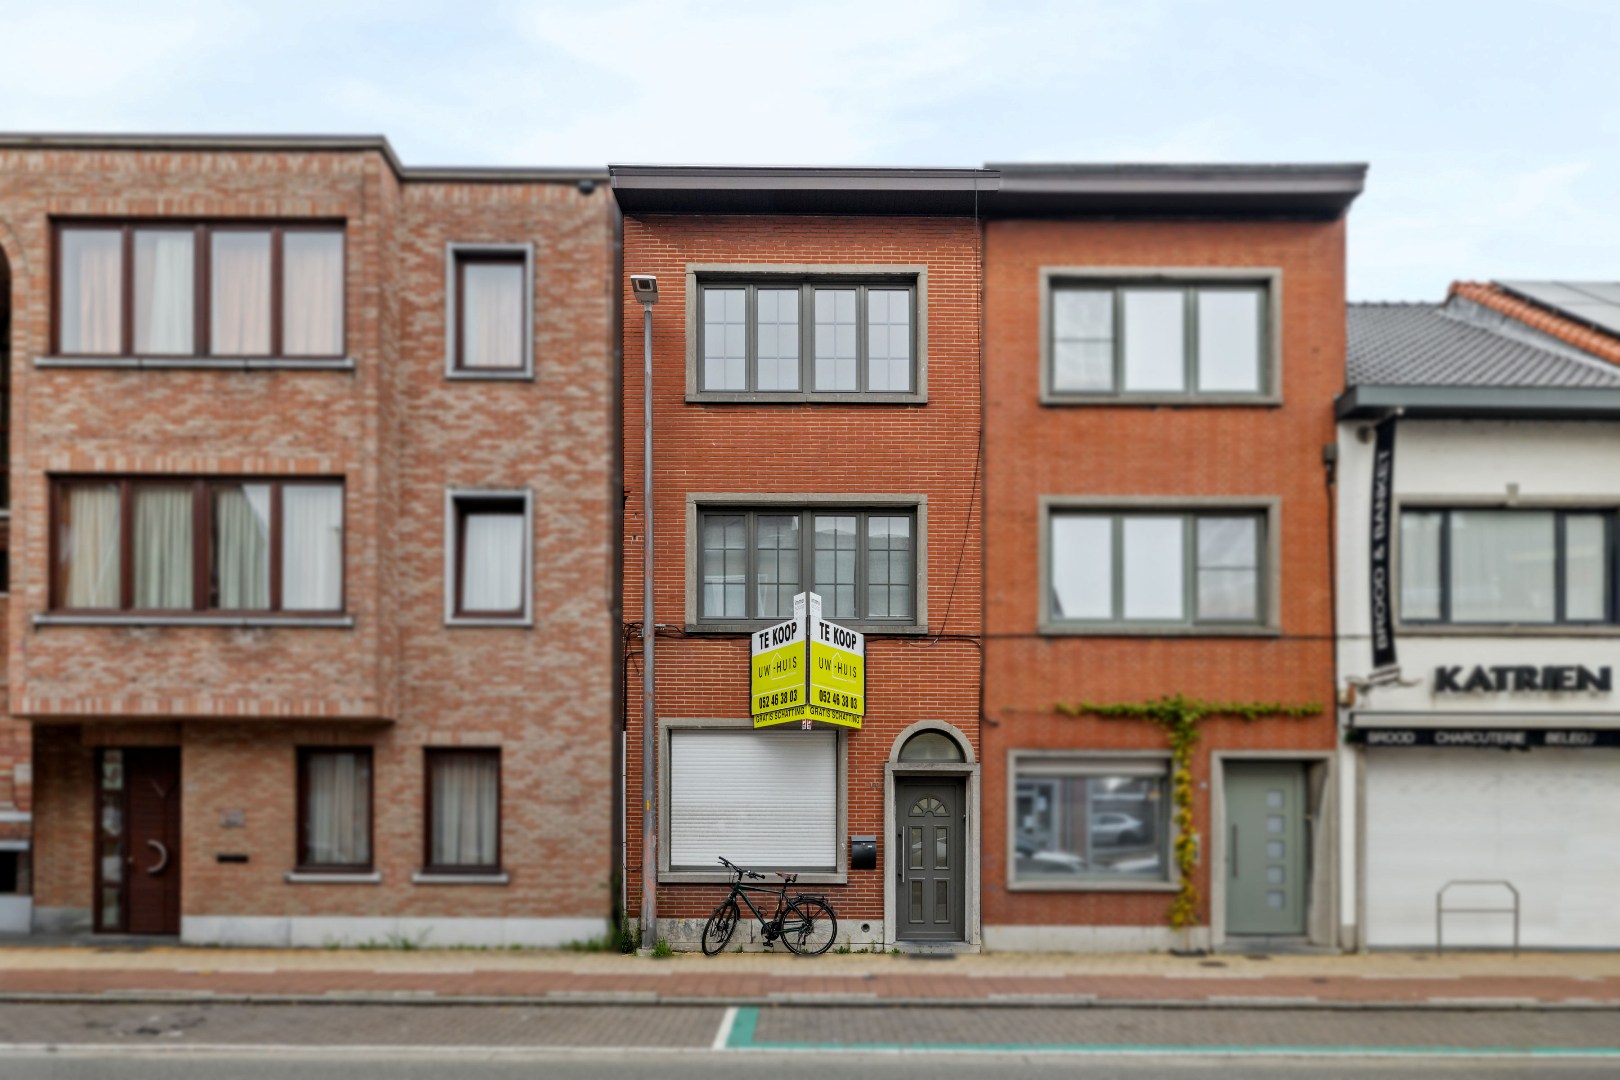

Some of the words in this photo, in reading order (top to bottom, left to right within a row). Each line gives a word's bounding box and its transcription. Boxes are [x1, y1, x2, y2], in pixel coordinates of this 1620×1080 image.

[1373, 451, 1390, 540] BANKET
[1374, 544, 1385, 561] &
[1373, 566, 1389, 651] BROOD
[759, 631, 769, 650] TE
[772, 621, 798, 647] KOOP
[819, 621, 830, 642] TE
[833, 626, 857, 650] KOOP
[1434, 663, 1612, 692] KATRIEN
[758, 696, 770, 710] 052
[771, 693, 779, 706] 46
[780, 691, 788, 704] 38
[789, 689, 798, 703] 03
[819, 689, 831, 704] 052
[832, 692, 840, 706] 46
[841, 694, 849, 708] 38
[850, 696, 858, 710] 03
[774, 706, 805, 720] SCHATTING
[831, 710, 860, 724] SCHATTING
[1367, 731, 1415, 744] BROOD
[1434, 731, 1526, 744] CHARCUTERIE
